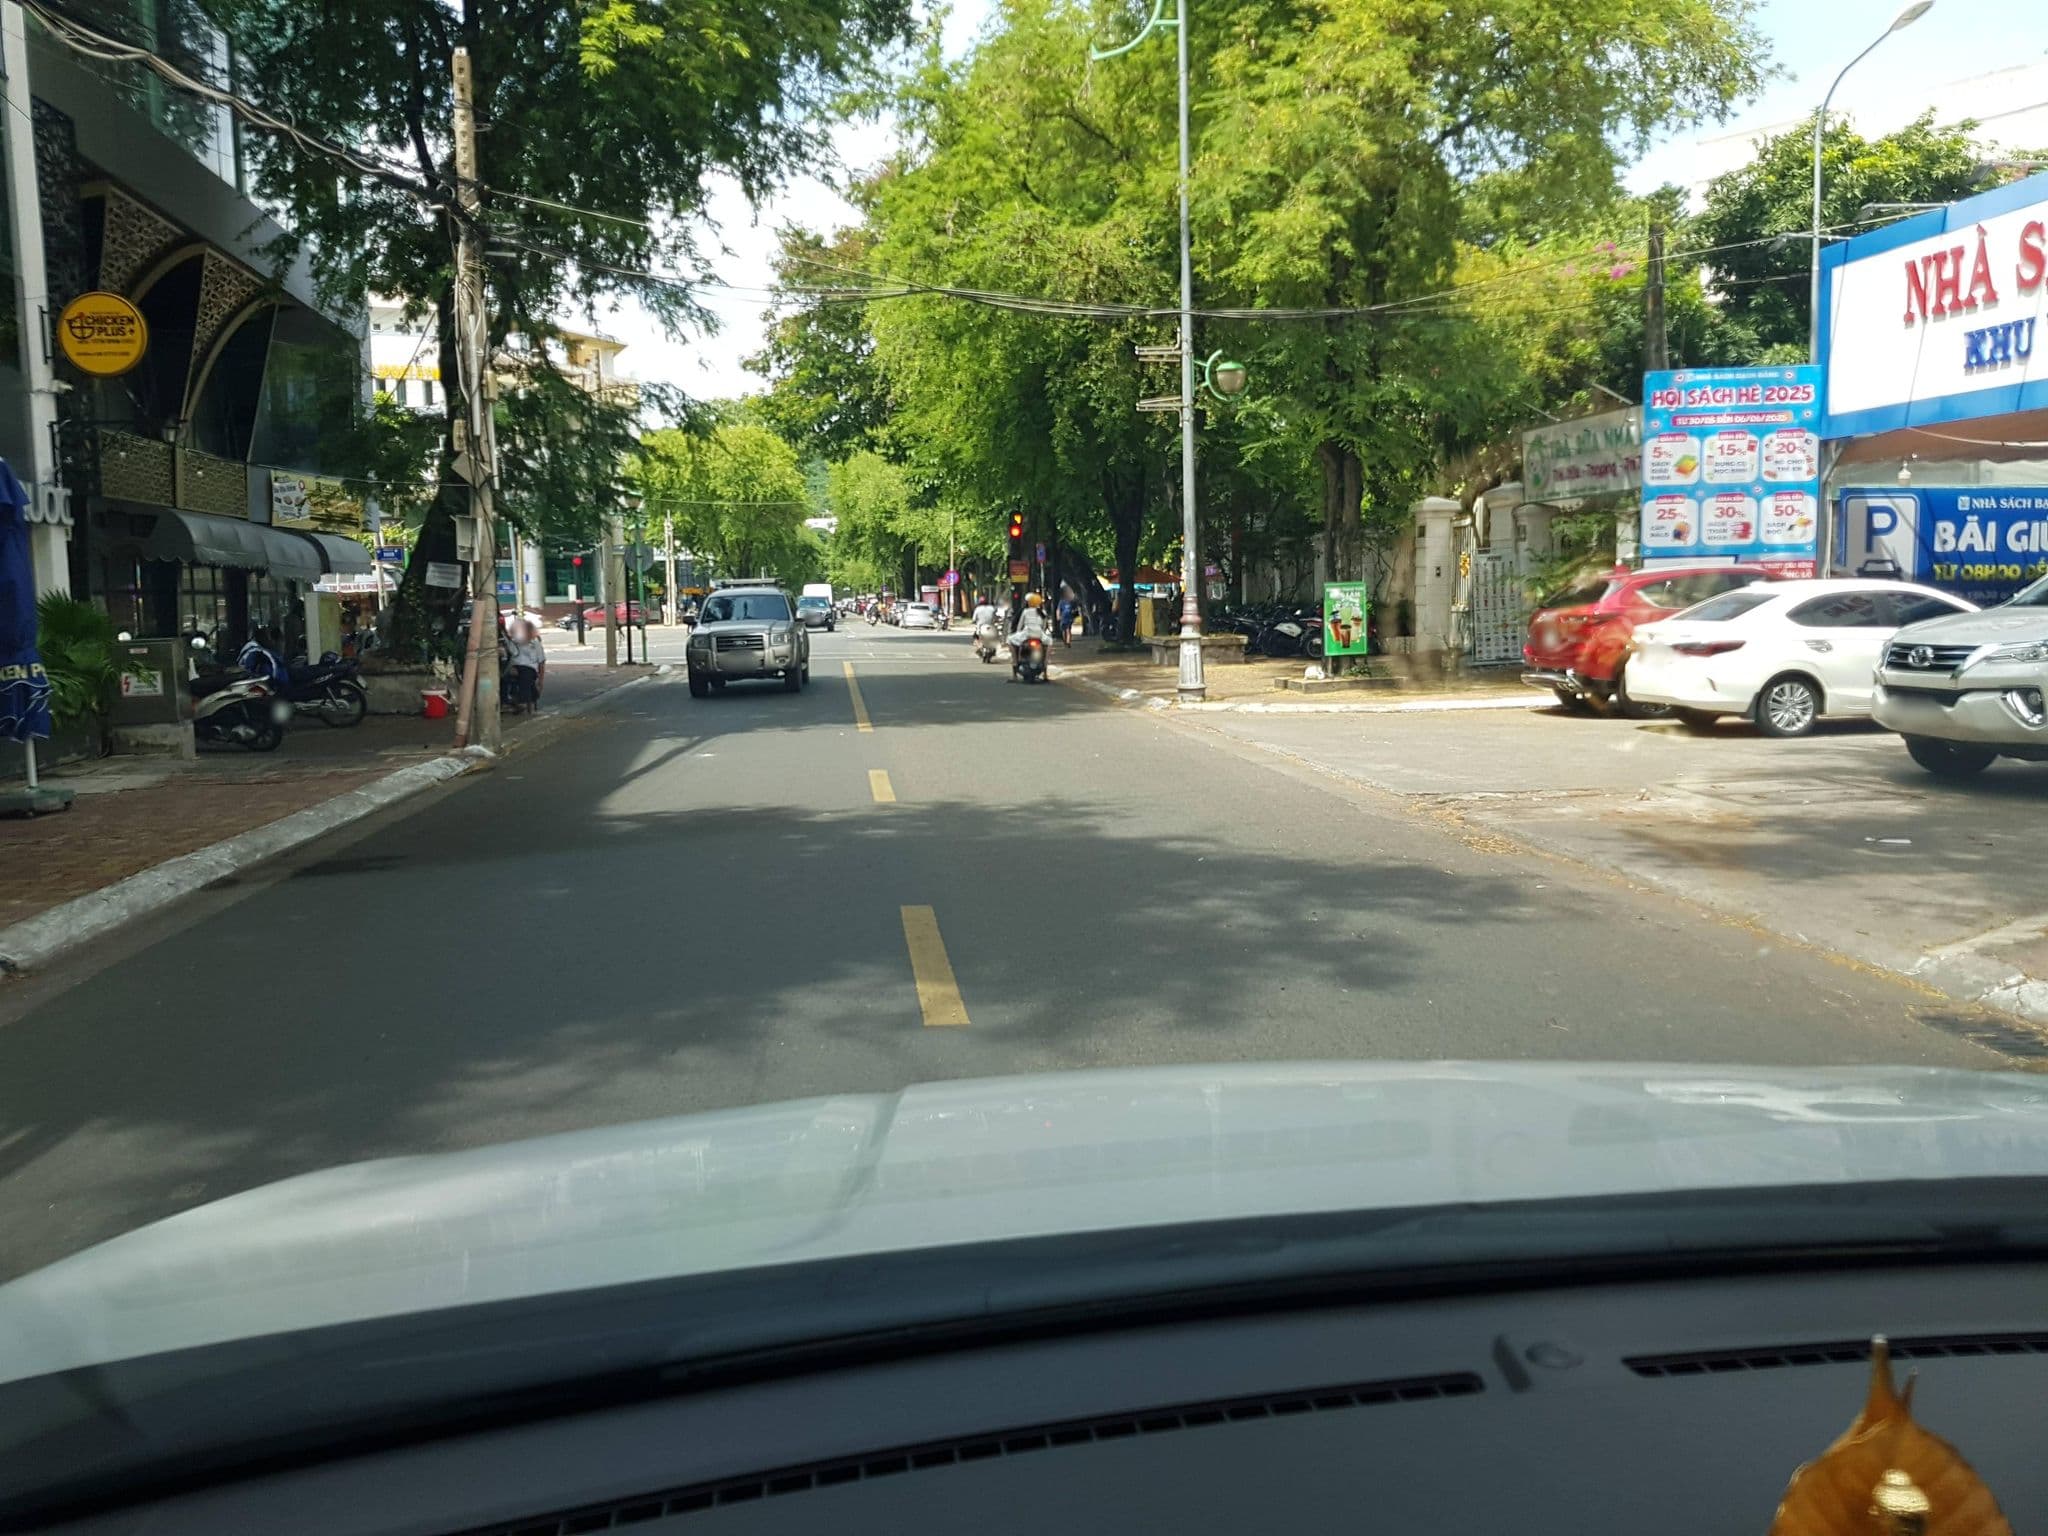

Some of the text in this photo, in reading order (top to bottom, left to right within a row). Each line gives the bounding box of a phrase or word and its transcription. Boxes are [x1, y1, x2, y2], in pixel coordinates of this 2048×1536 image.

[1904, 223, 1998, 322] NHÀ
[85, 315, 134, 325] CHICKEN
[1964, 317, 2036, 369] KHU
[1652, 386, 1682, 410] HỘI
[1687, 385, 1734, 405] SÁCH
[1765, 384, 1814, 403] 2025
[1972, 496, 1997, 509] NHÀ
[2000, 495, 2031, 509] SÁCH
[1866, 505, 1898, 553] P
[1934, 515, 1997, 552] BÃI
